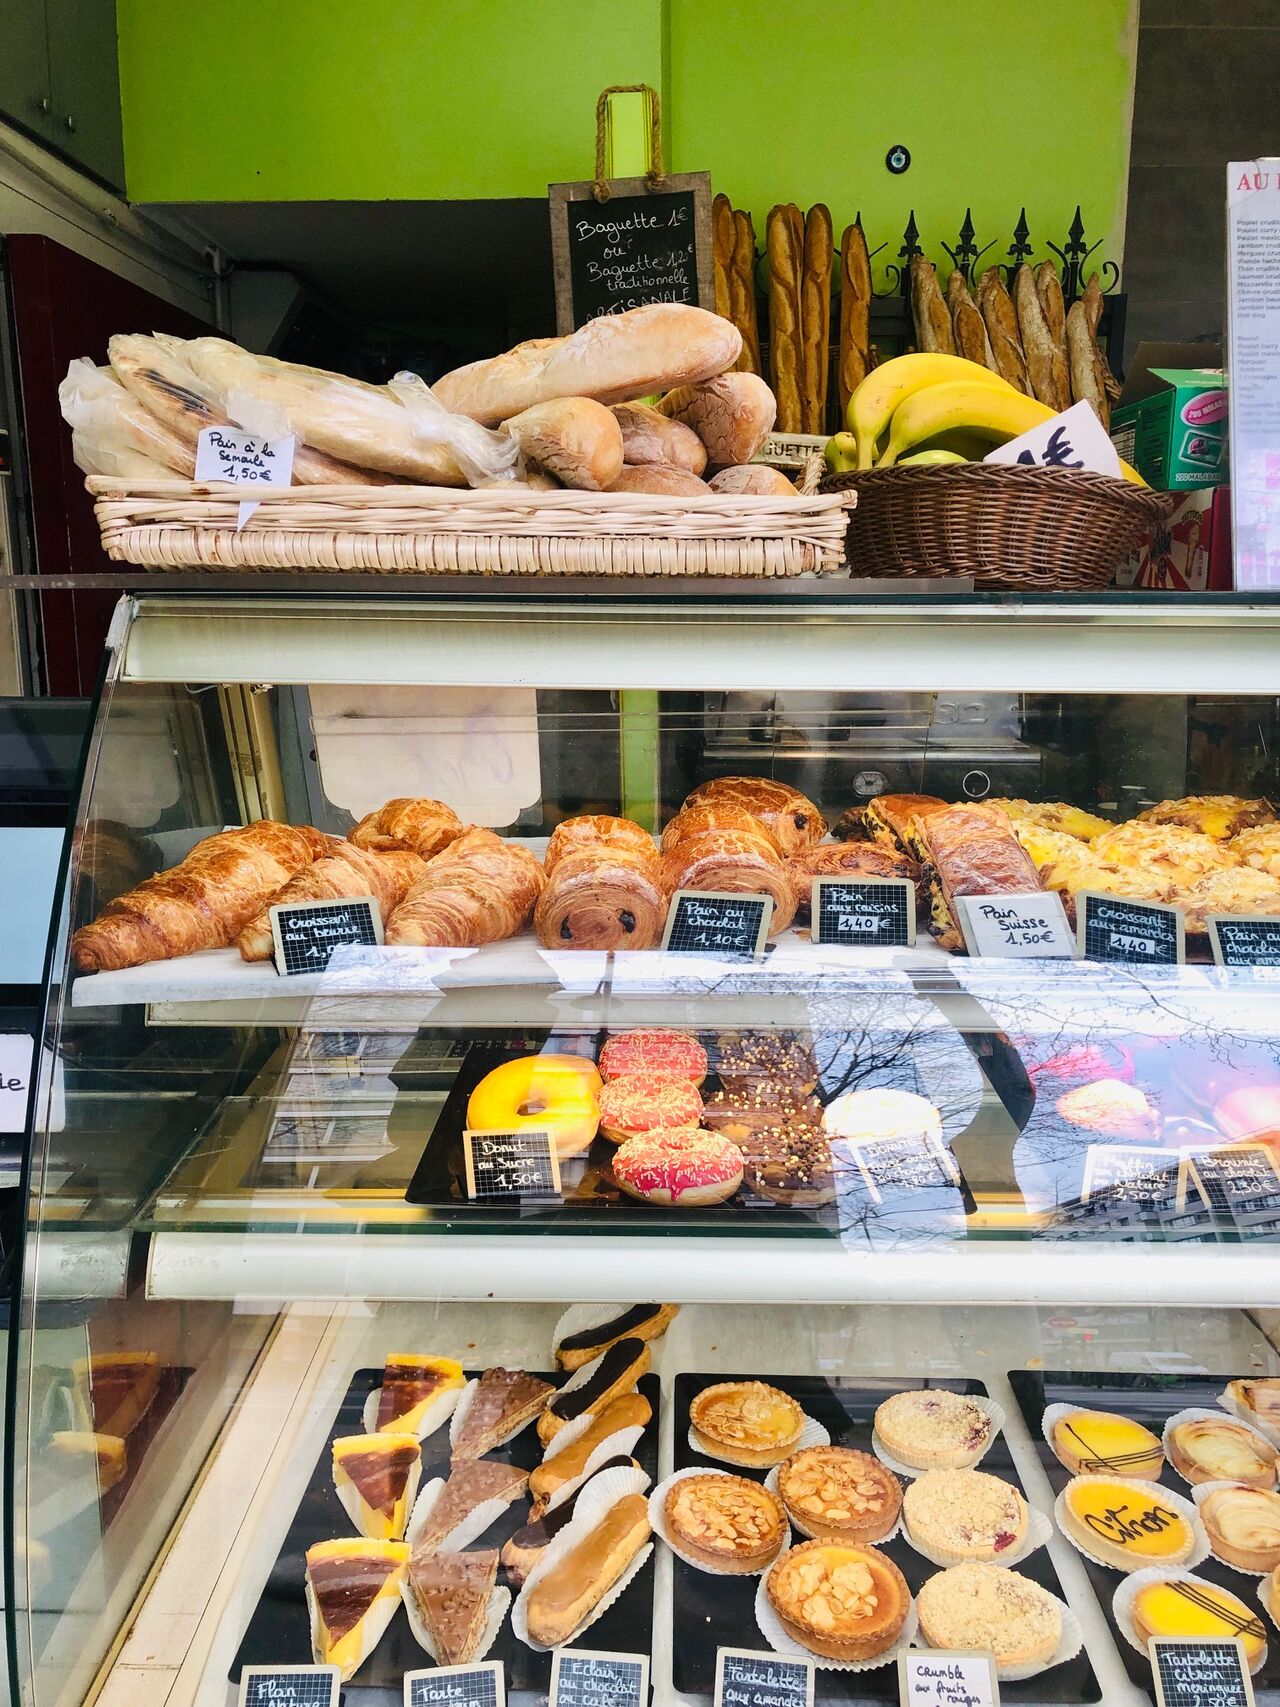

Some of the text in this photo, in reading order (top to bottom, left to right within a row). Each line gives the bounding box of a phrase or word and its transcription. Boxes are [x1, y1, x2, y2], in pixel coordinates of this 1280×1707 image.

[1237, 173, 1269, 190] AU
[576, 207, 688, 243] Baguette 1€
[587, 254, 663, 282] Baguette
[607, 269, 689, 291] traditionnelle
[209, 431, 275, 458] Pain à la
[763, 442, 821, 457] GUETTE
[222, 465, 272, 481] 1,50€
[829, 887, 864, 902] Pain
[685, 902, 744, 917] Pain au
[827, 904, 899, 913] aux raisins
[979, 905, 1018, 919] Pain
[289, 912, 350, 929] Croissant
[688, 916, 745, 930] chocolat
[998, 918, 1048, 931] Suisse
[1089, 919, 1115, 930] aux
[1097, 906, 1167, 928] Croissant
[314, 926, 361, 938] beurre
[694, 933, 748, 946] 1,10€
[1005, 931, 1055, 946] 1,50€
[1223, 926, 1259, 941] Pain
[1227, 956, 1252, 966] aux
[482, 1139, 527, 1155] Donut
[478, 1157, 535, 1170] au Sucre
[1200, 1156, 1264, 1168] Brownie
[1224, 1167, 1271, 1178] chocolat
[494, 1172, 543, 1190] 1,50€
[1114, 1179, 1166, 1190] Nature
[1084, 1504, 1179, 1545] Citron
[1161, 1650, 1236, 1666] Tartelette
[257, 1680, 296, 1700] Flan
[418, 1684, 463, 1702] Tarte
[583, 1678, 637, 1695] chocolat
[915, 1681, 967, 1700] aux fruits
[726, 1688, 749, 1705] aux
[947, 1695, 981, 1707] rouges
